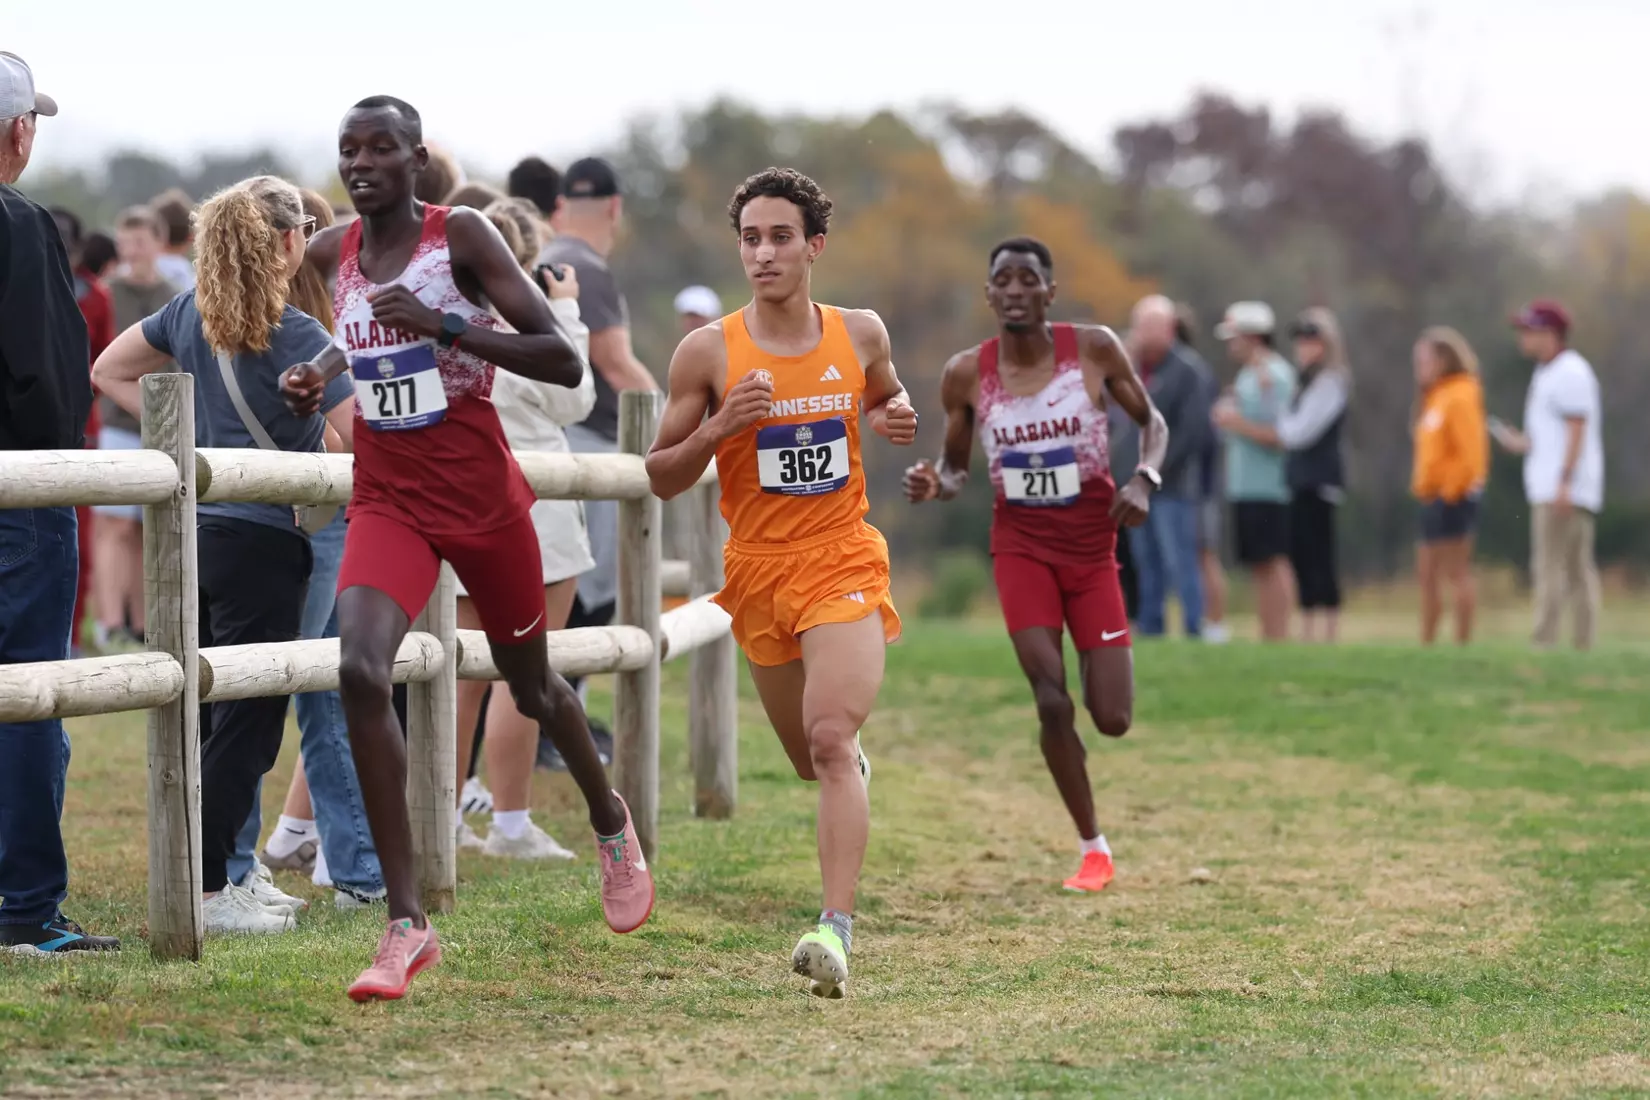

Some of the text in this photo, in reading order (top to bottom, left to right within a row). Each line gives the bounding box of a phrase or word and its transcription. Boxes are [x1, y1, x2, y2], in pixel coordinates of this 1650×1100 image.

[345, 313, 431, 351] ALABA
[372, 377, 416, 417] 277
[763, 393, 852, 418] NNESSEE
[993, 417, 1081, 446] ALABAMA
[779, 445, 834, 484] 362
[1023, 471, 1058, 496] 271
